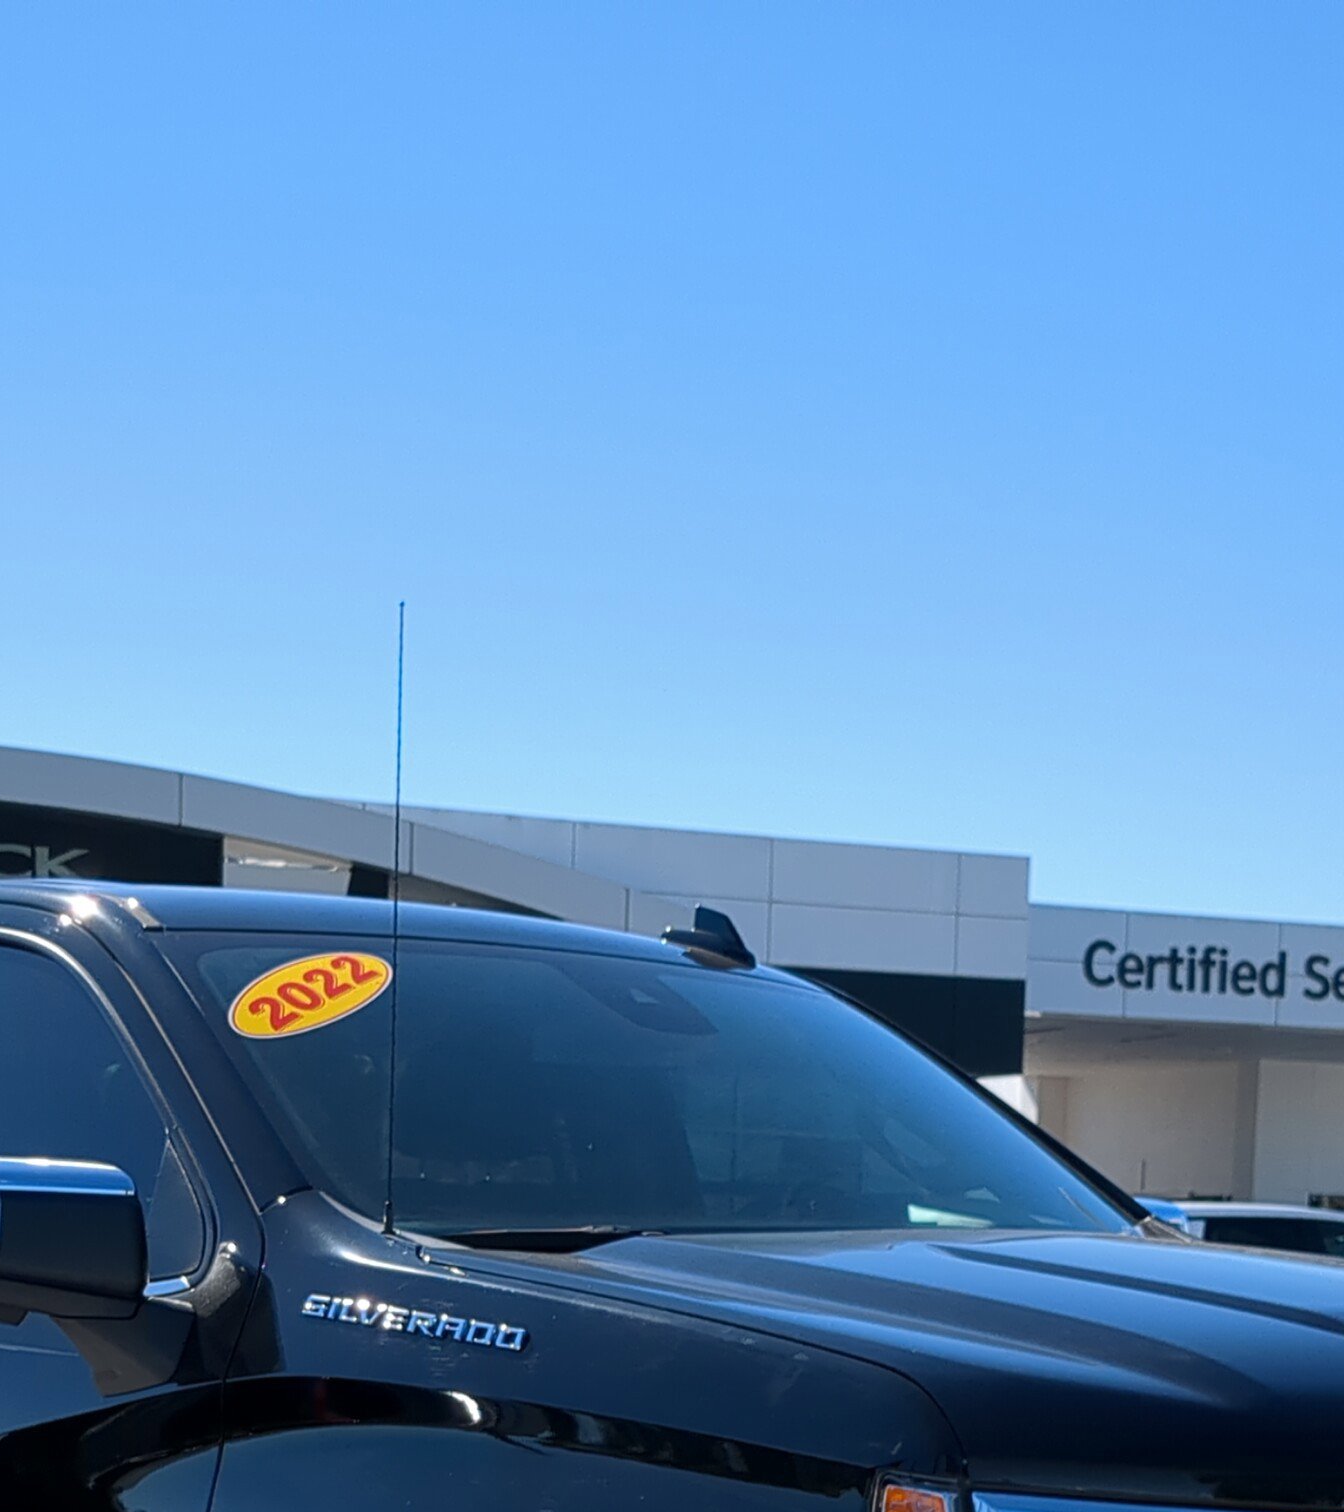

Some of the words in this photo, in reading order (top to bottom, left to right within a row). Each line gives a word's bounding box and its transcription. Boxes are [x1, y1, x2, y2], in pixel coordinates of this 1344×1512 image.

[248, 956, 383, 1031] 2022
[1083, 940, 1287, 998] Certified
[302, 1293, 527, 1351] SILVERADO
